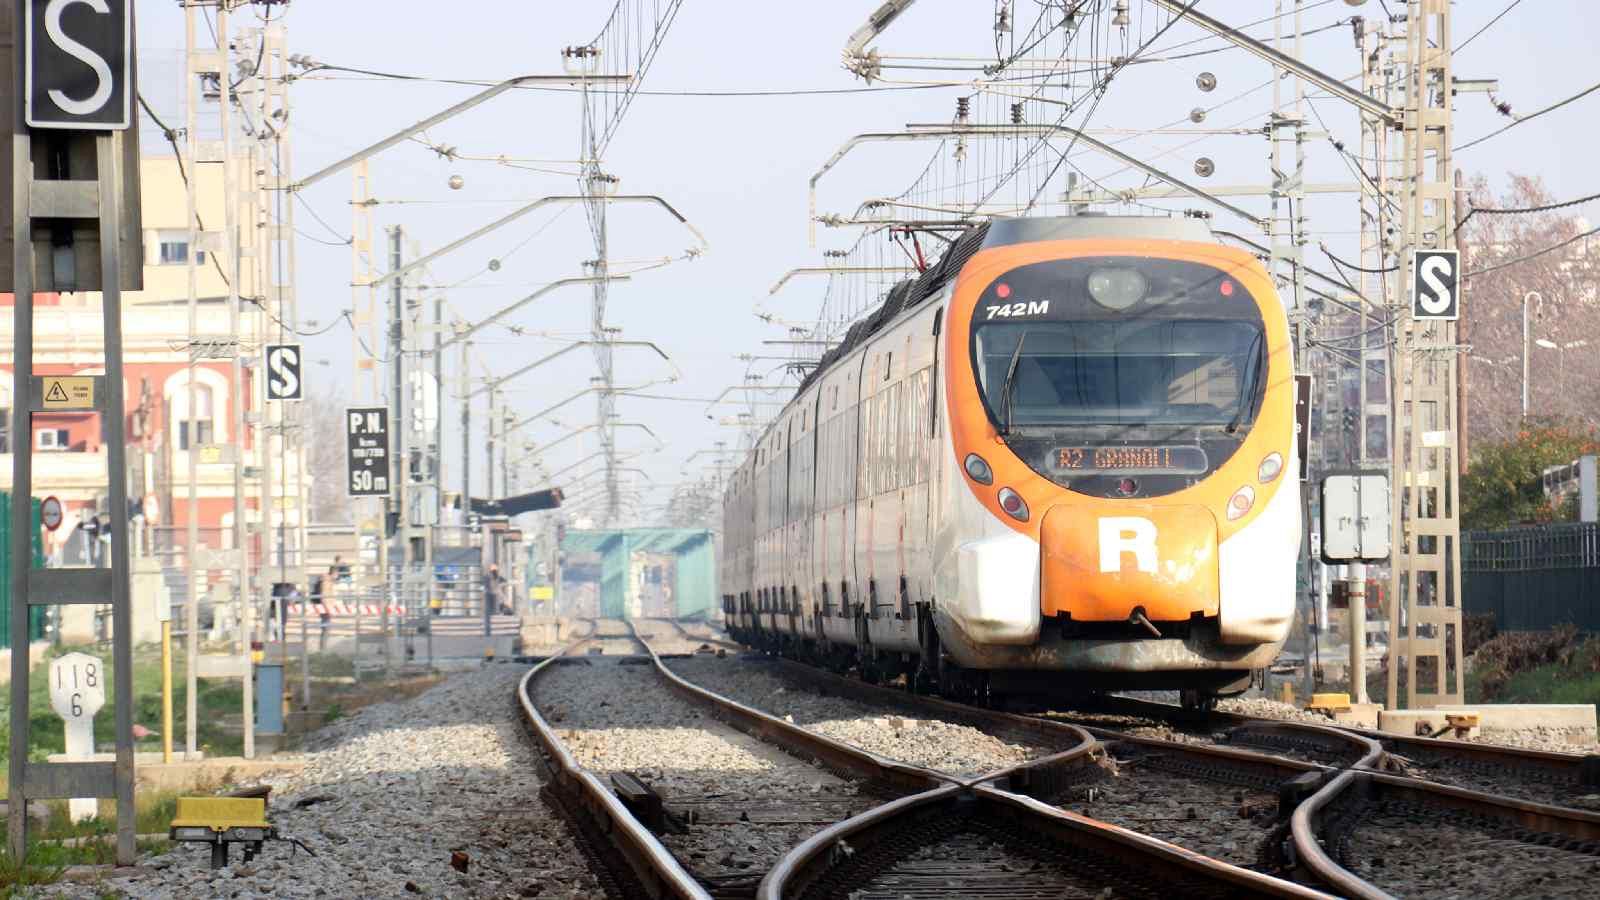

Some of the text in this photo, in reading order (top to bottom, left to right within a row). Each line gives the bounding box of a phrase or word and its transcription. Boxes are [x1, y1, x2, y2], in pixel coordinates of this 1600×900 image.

[45, 0, 113, 115] S
[1421, 255, 1452, 314] S
[986, 300, 1050, 320] 742M
[270, 348, 298, 397] S
[350, 412, 385, 434] P.N.
[1059, 448, 1083, 468] R2
[1098, 516, 1158, 573] R
[57, 663, 97, 687] 118
[71, 693, 83, 717] 6
